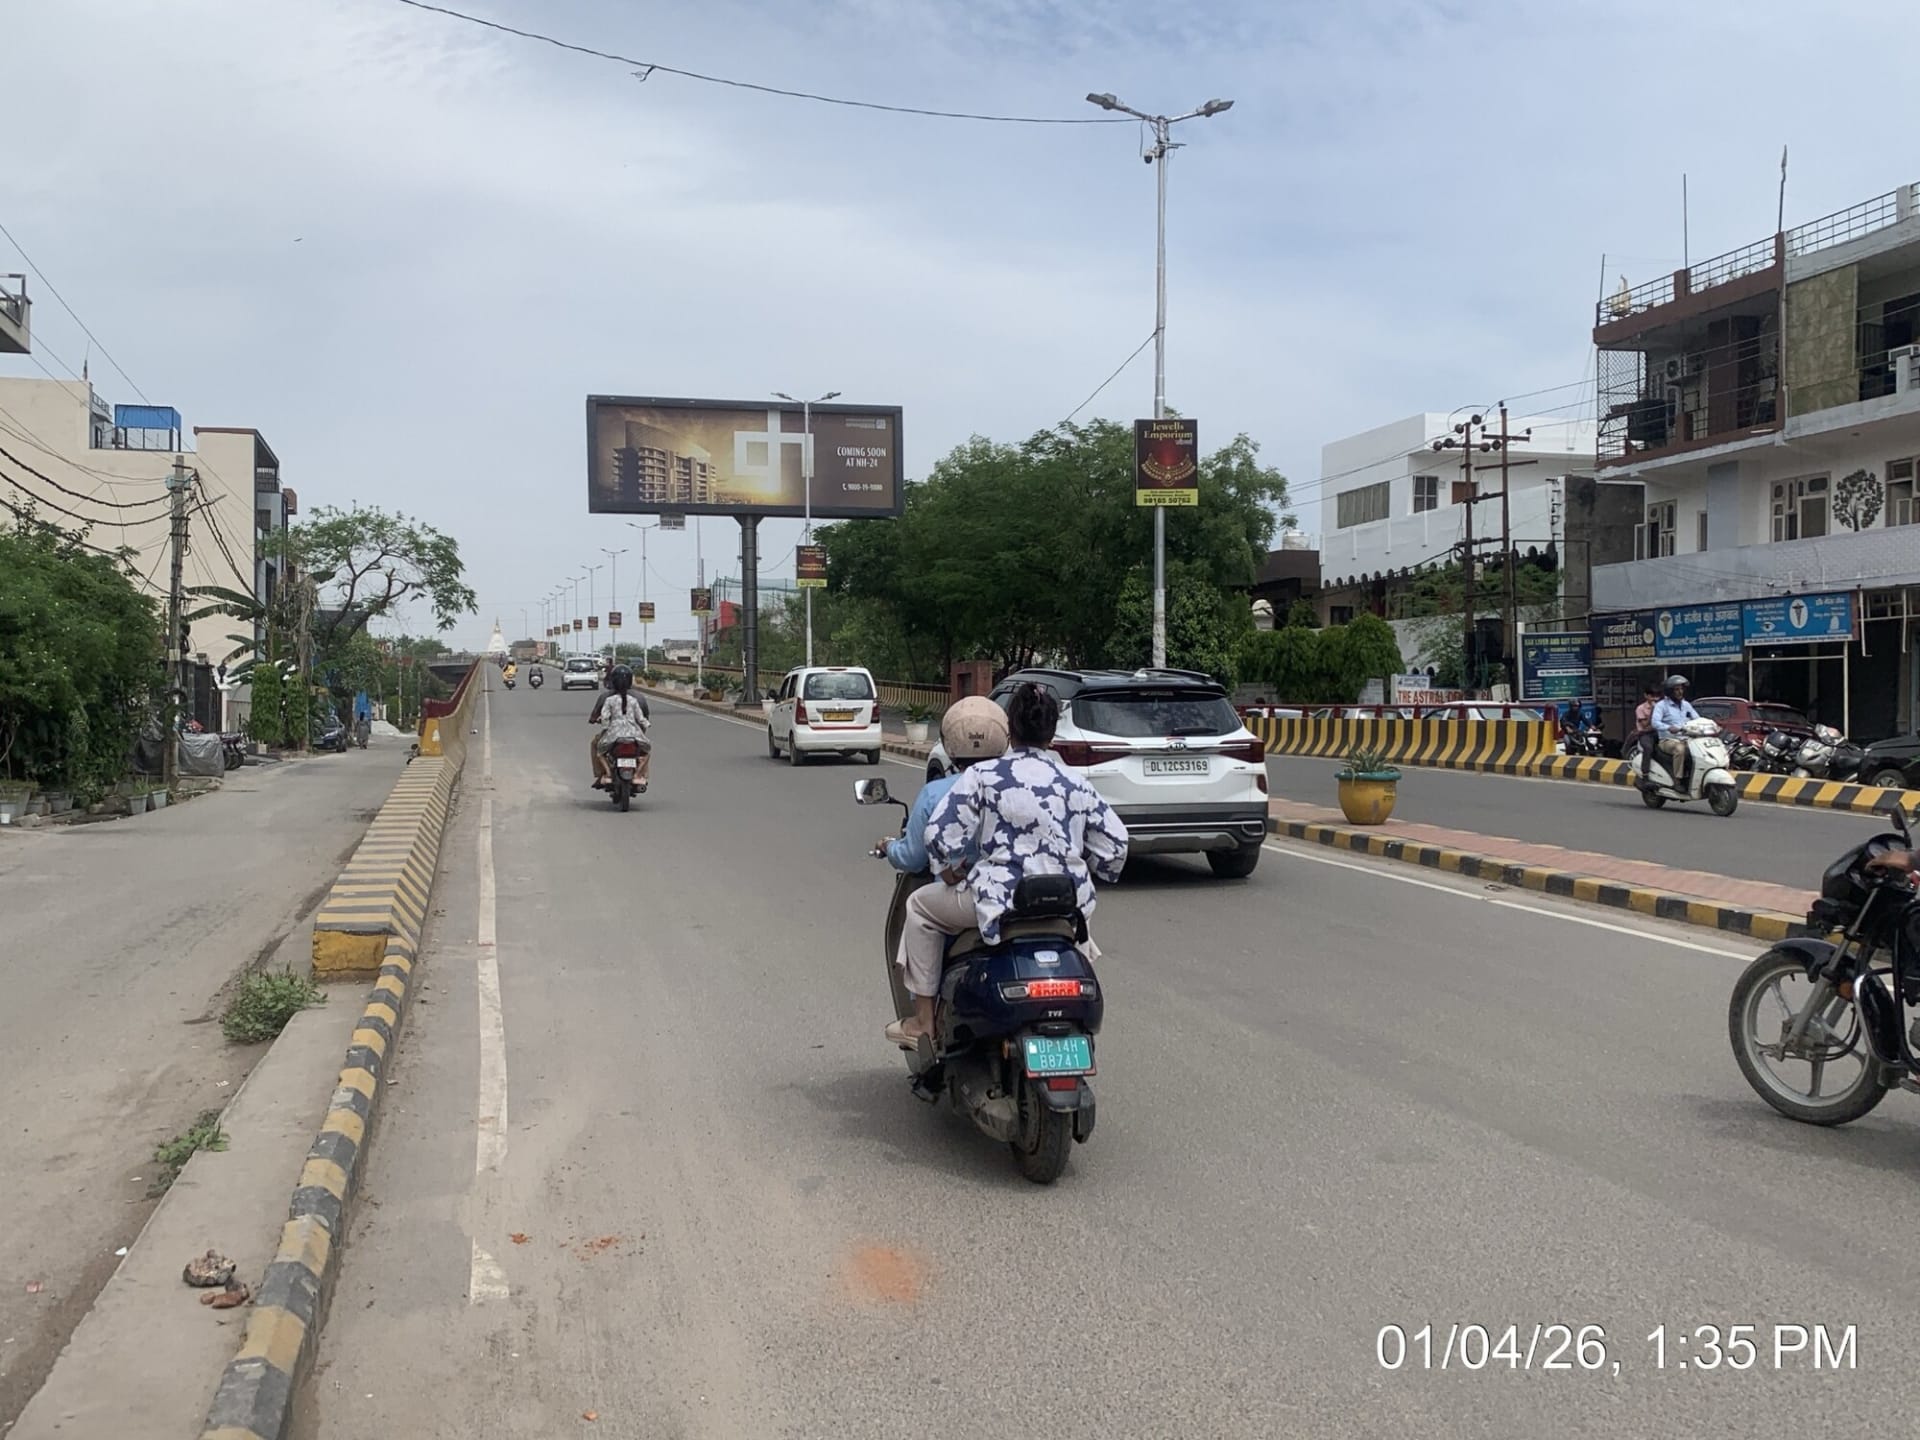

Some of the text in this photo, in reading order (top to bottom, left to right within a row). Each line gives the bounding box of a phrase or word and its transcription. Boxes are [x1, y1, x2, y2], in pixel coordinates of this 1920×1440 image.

[1152, 421, 1184, 432] Jewells
[1143, 430, 1193, 441] Emporium
[837, 446, 887, 457] COMING SOON
[845, 457, 878, 468] AT NH-24
[1603, 634, 1643, 647] MEDICINES
[1398, 690, 1411, 703] THE
[1413, 690, 1445, 704] ASTRAL
[1150, 760, 1208, 772] DL12CS3169
[1039, 1053, 1080, 1069] B8741
